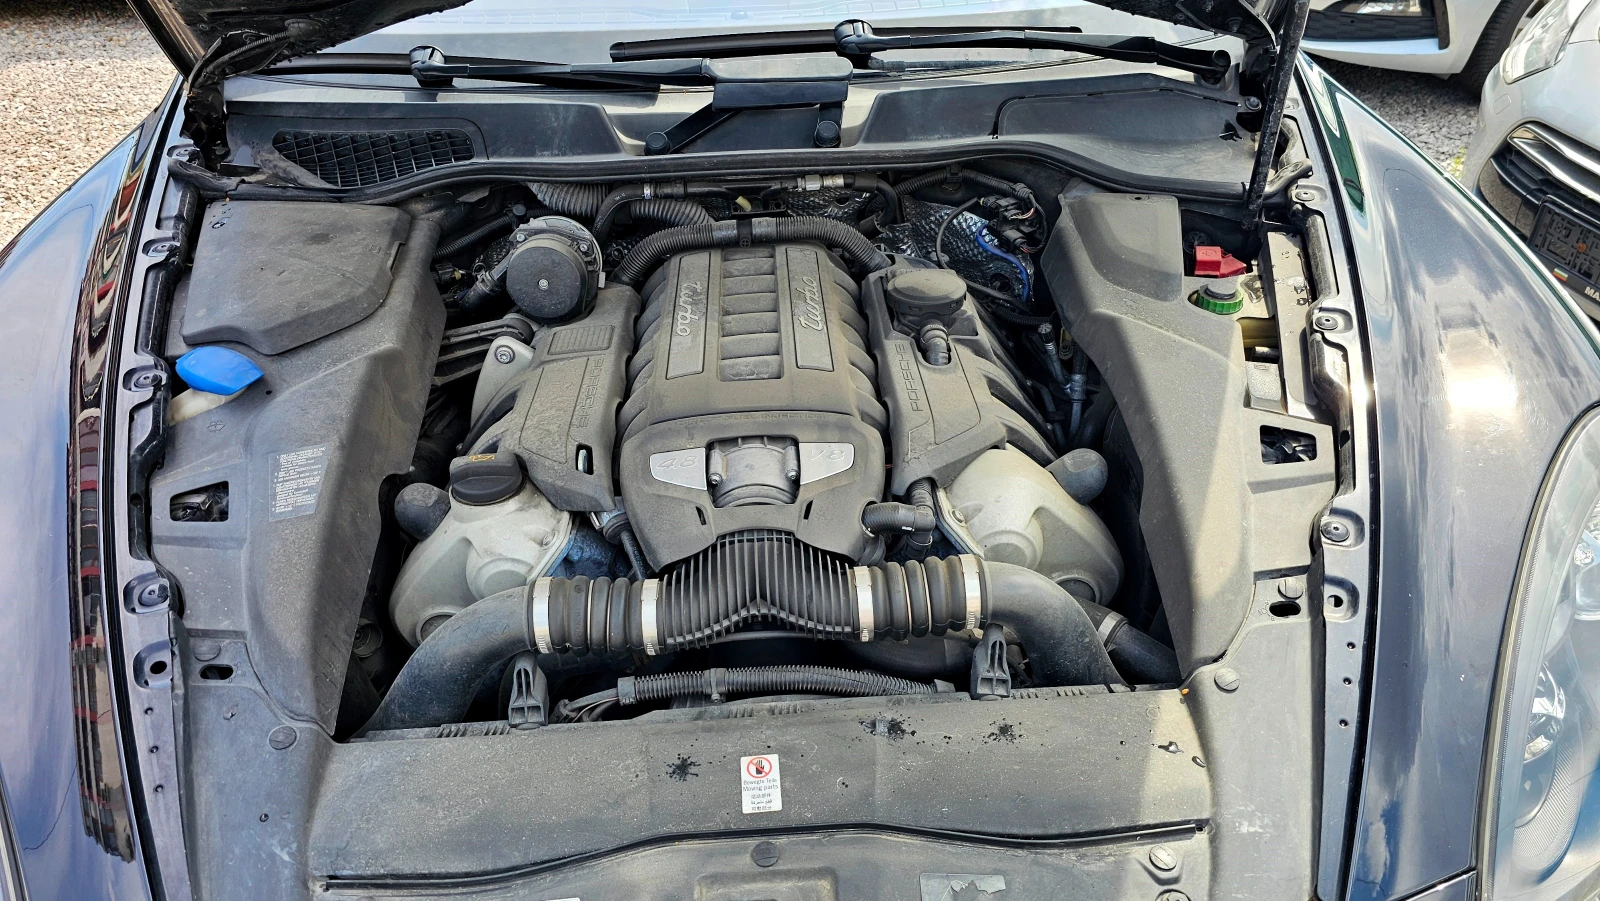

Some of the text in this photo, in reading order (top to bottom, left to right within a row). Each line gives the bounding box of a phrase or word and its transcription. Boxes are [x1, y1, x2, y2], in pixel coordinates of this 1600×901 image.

[1584, 286, 1600, 302] MA
[573, 358, 605, 428] PORSCHE
[895, 344, 924, 411] PORSCHE
